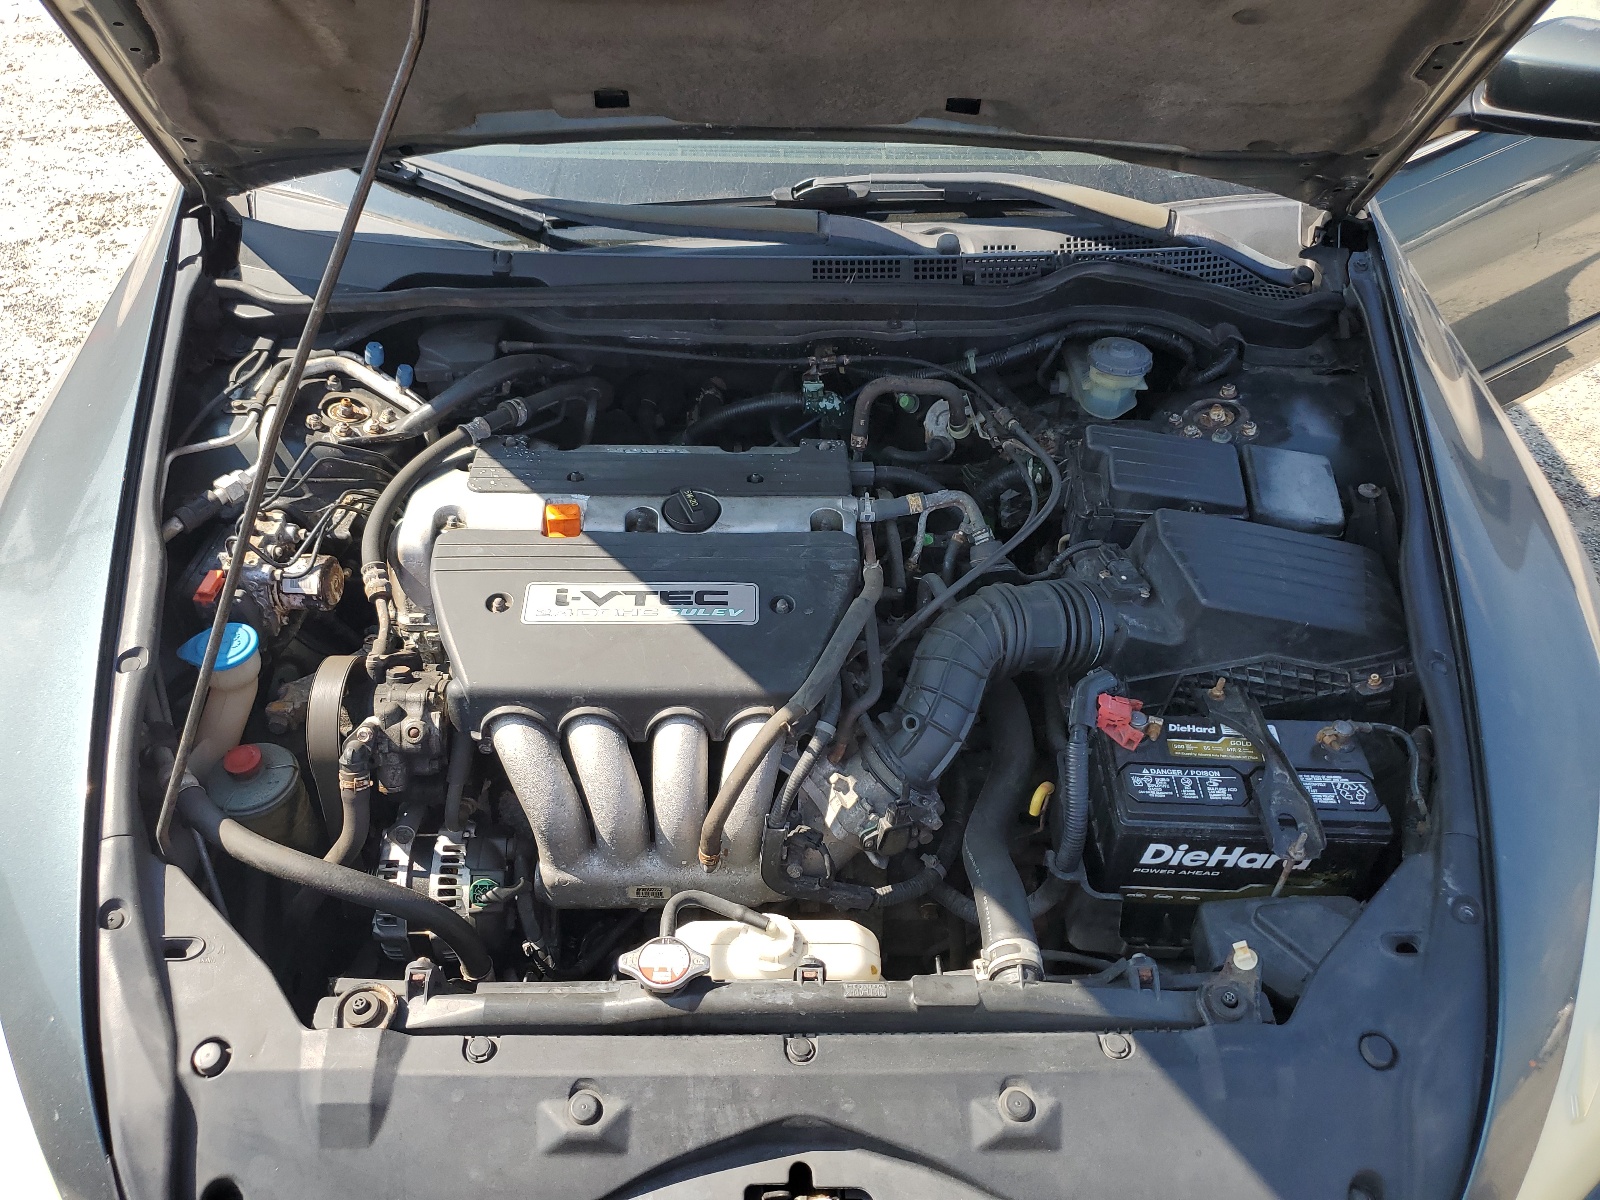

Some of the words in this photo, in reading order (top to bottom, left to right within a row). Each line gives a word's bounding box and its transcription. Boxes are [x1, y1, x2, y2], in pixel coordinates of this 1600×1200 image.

[555, 588, 729, 607] i-VTEC
[669, 608, 746, 617] SULEV
[1168, 723, 1216, 734] DieHard
[1150, 768, 1183, 776] DANGER
[1132, 867, 1175, 875] POWER
